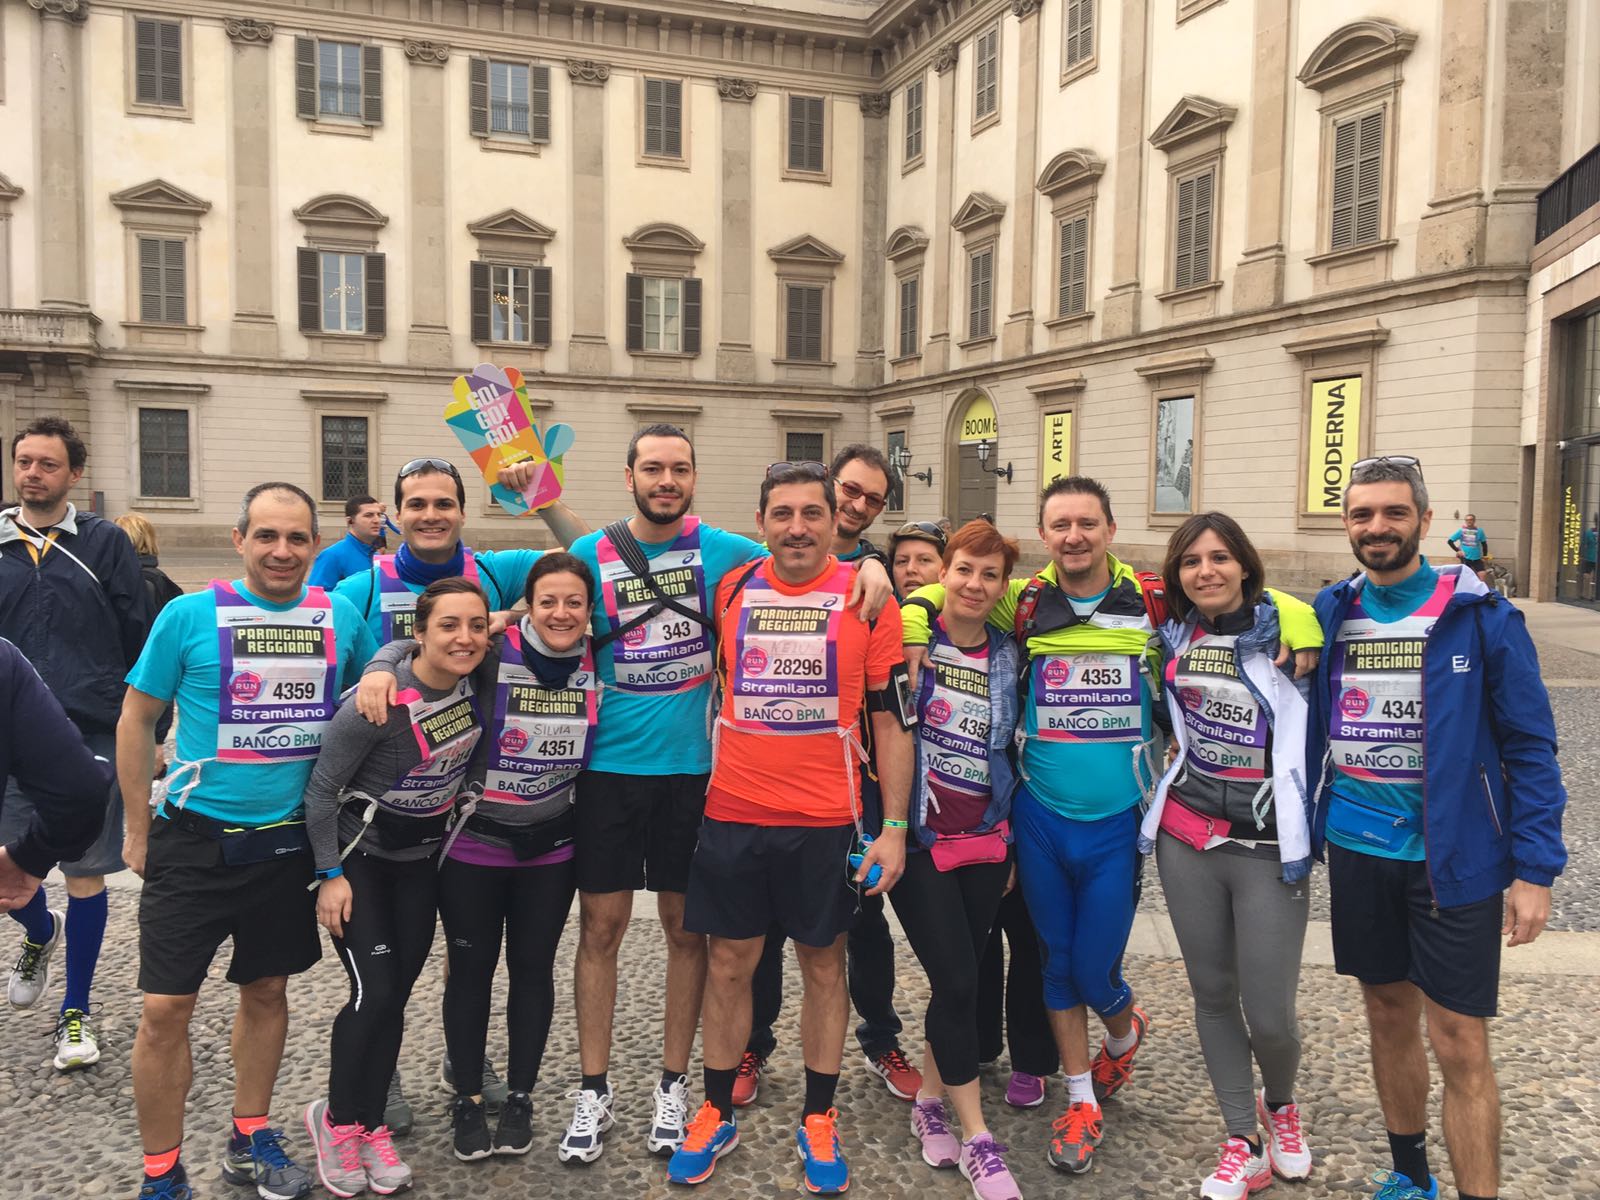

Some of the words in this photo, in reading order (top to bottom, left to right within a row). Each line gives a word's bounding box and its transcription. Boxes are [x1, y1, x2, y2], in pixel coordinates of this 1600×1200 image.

[466, 383, 500, 410] GO!
[475, 402, 511, 430] GO!
[965, 418, 991, 435] BOOM
[484, 421, 520, 449] GO!
[1052, 416, 1064, 462] ARTE
[1323, 382, 1346, 508] MODERNA
[1562, 486, 1572, 565] BIGLIETTERIA
[1569, 503, 1577, 549] MUSEO
[617, 569, 692, 593] PARGIANO
[752, 609, 828, 620] PARMIGIANO
[662, 621, 691, 641] 343
[758, 620, 817, 631] REGGIANO
[237, 628, 322, 641] PARMIGIANO
[247, 641, 314, 653] REGGIANO
[624, 641, 704, 660] Stramilano
[1349, 641, 1427, 655] PARMIGIAN
[773, 658, 823, 676] 28296
[1356, 655, 1422, 669] REGGIANO
[627, 670, 678, 684] BANCO
[680, 664, 705, 679] BPM
[1081, 668, 1122, 685] 4353
[273, 682, 316, 700] 4359
[512, 686, 584, 702] PARMIGIANO
[741, 682, 827, 694] Stramilano
[1045, 693, 1132, 703] Stramilano
[231, 708, 326, 720] Stramilano
[519, 700, 577, 714] REGGIANO
[744, 707, 793, 720] BANCO
[796, 708, 825, 720] BPM
[930, 707, 948, 716] RUN
[1205, 699, 1253, 725] 23554
[1382, 700, 1423, 719] 4347
[421, 701, 472, 734] PARMIGIANO
[1048, 717, 1099, 729] BANCO
[1102, 717, 1131, 729] BPM
[432, 715, 473, 743] REGGIANO
[959, 717, 991, 740] 4352
[1185, 712, 1255, 744] Stramilano
[233, 735, 290, 748] BANCO
[294, 733, 322, 746] BPM
[504, 737, 524, 745] RUN
[537, 740, 575, 756] 4351
[499, 759, 582, 773] Stramilano
[1221, 753, 1252, 767] BPM
[1345, 753, 1403, 768] BANCO
[964, 767, 991, 784] BPM
[498, 780, 546, 794] BANCO
[391, 796, 440, 808] BANCO
